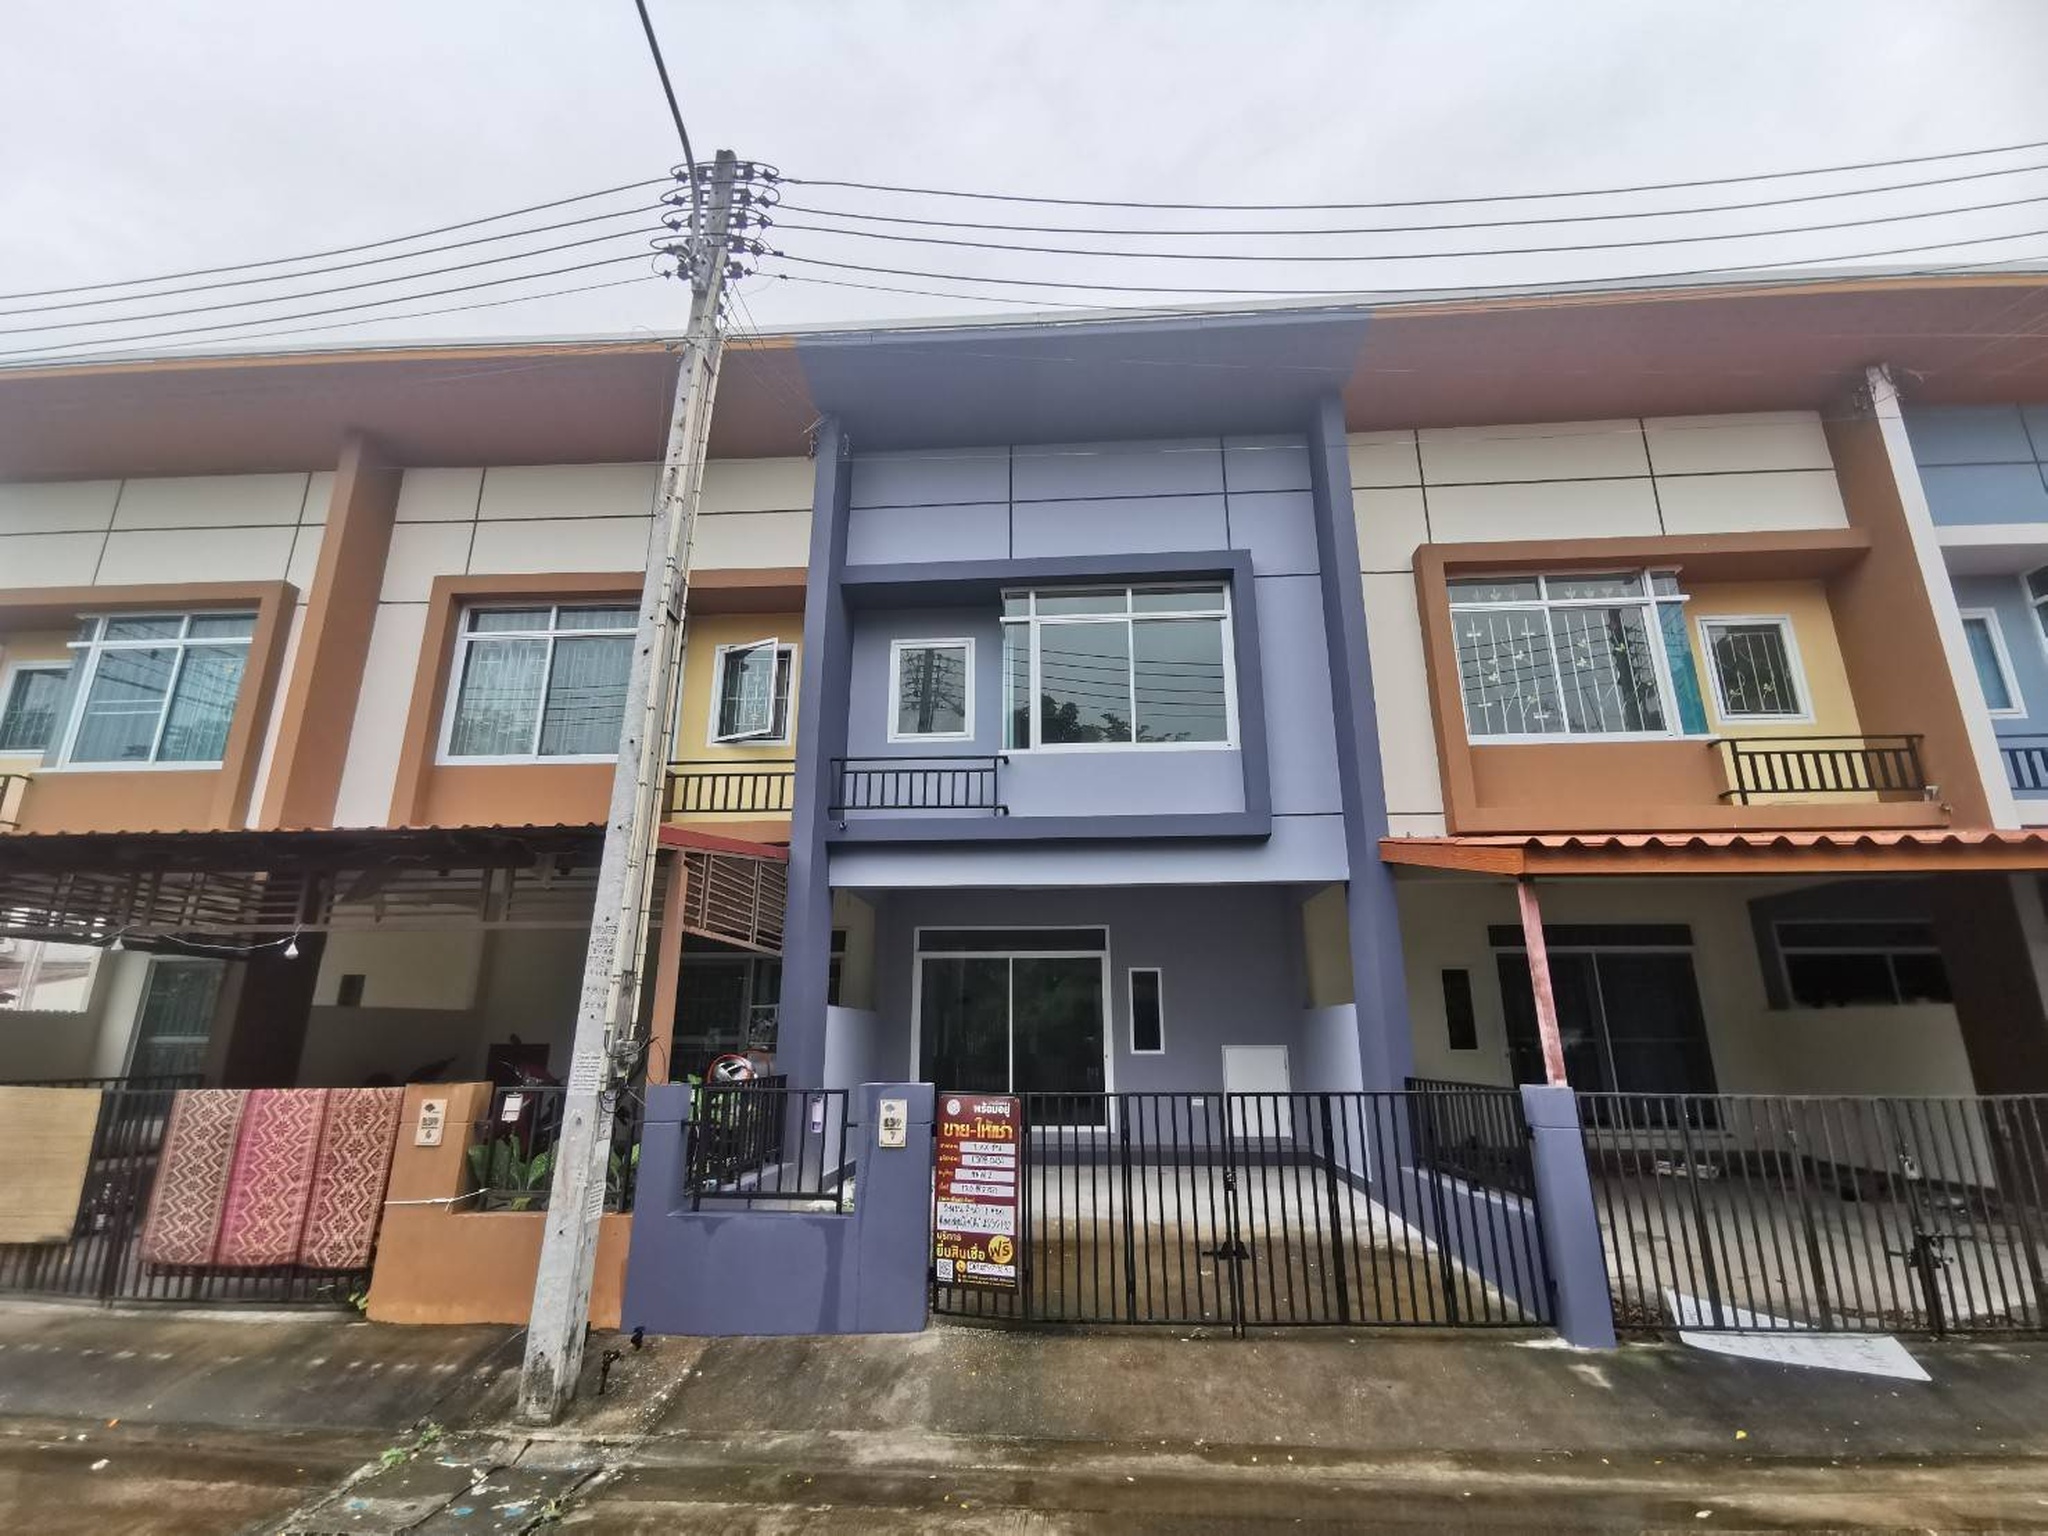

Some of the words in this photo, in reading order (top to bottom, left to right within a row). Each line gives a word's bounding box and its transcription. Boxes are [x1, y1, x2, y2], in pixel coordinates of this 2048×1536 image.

[973, 1101, 1011, 1118] พร้อมอยู่
[990, 1238, 1011, 1257] ฟรี
